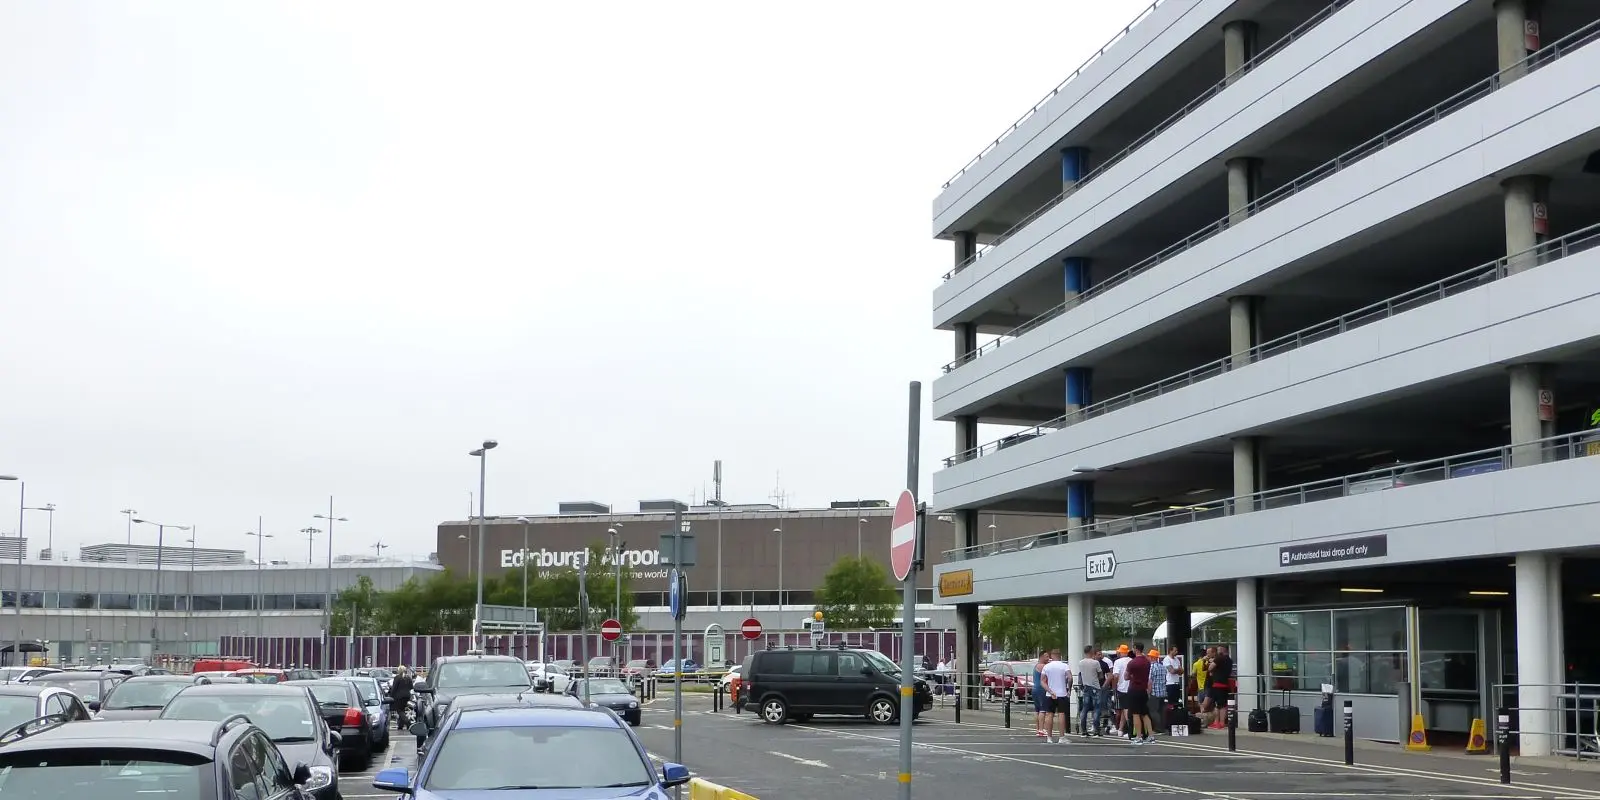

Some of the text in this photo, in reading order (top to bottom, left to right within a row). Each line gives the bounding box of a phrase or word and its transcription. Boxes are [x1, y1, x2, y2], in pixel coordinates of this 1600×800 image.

[602, 546, 660, 568] Airpor
[1291, 545, 1368, 561] Authorised taxi drop off only
[644, 568, 669, 579] world
[1089, 559, 1106, 574] Exit
